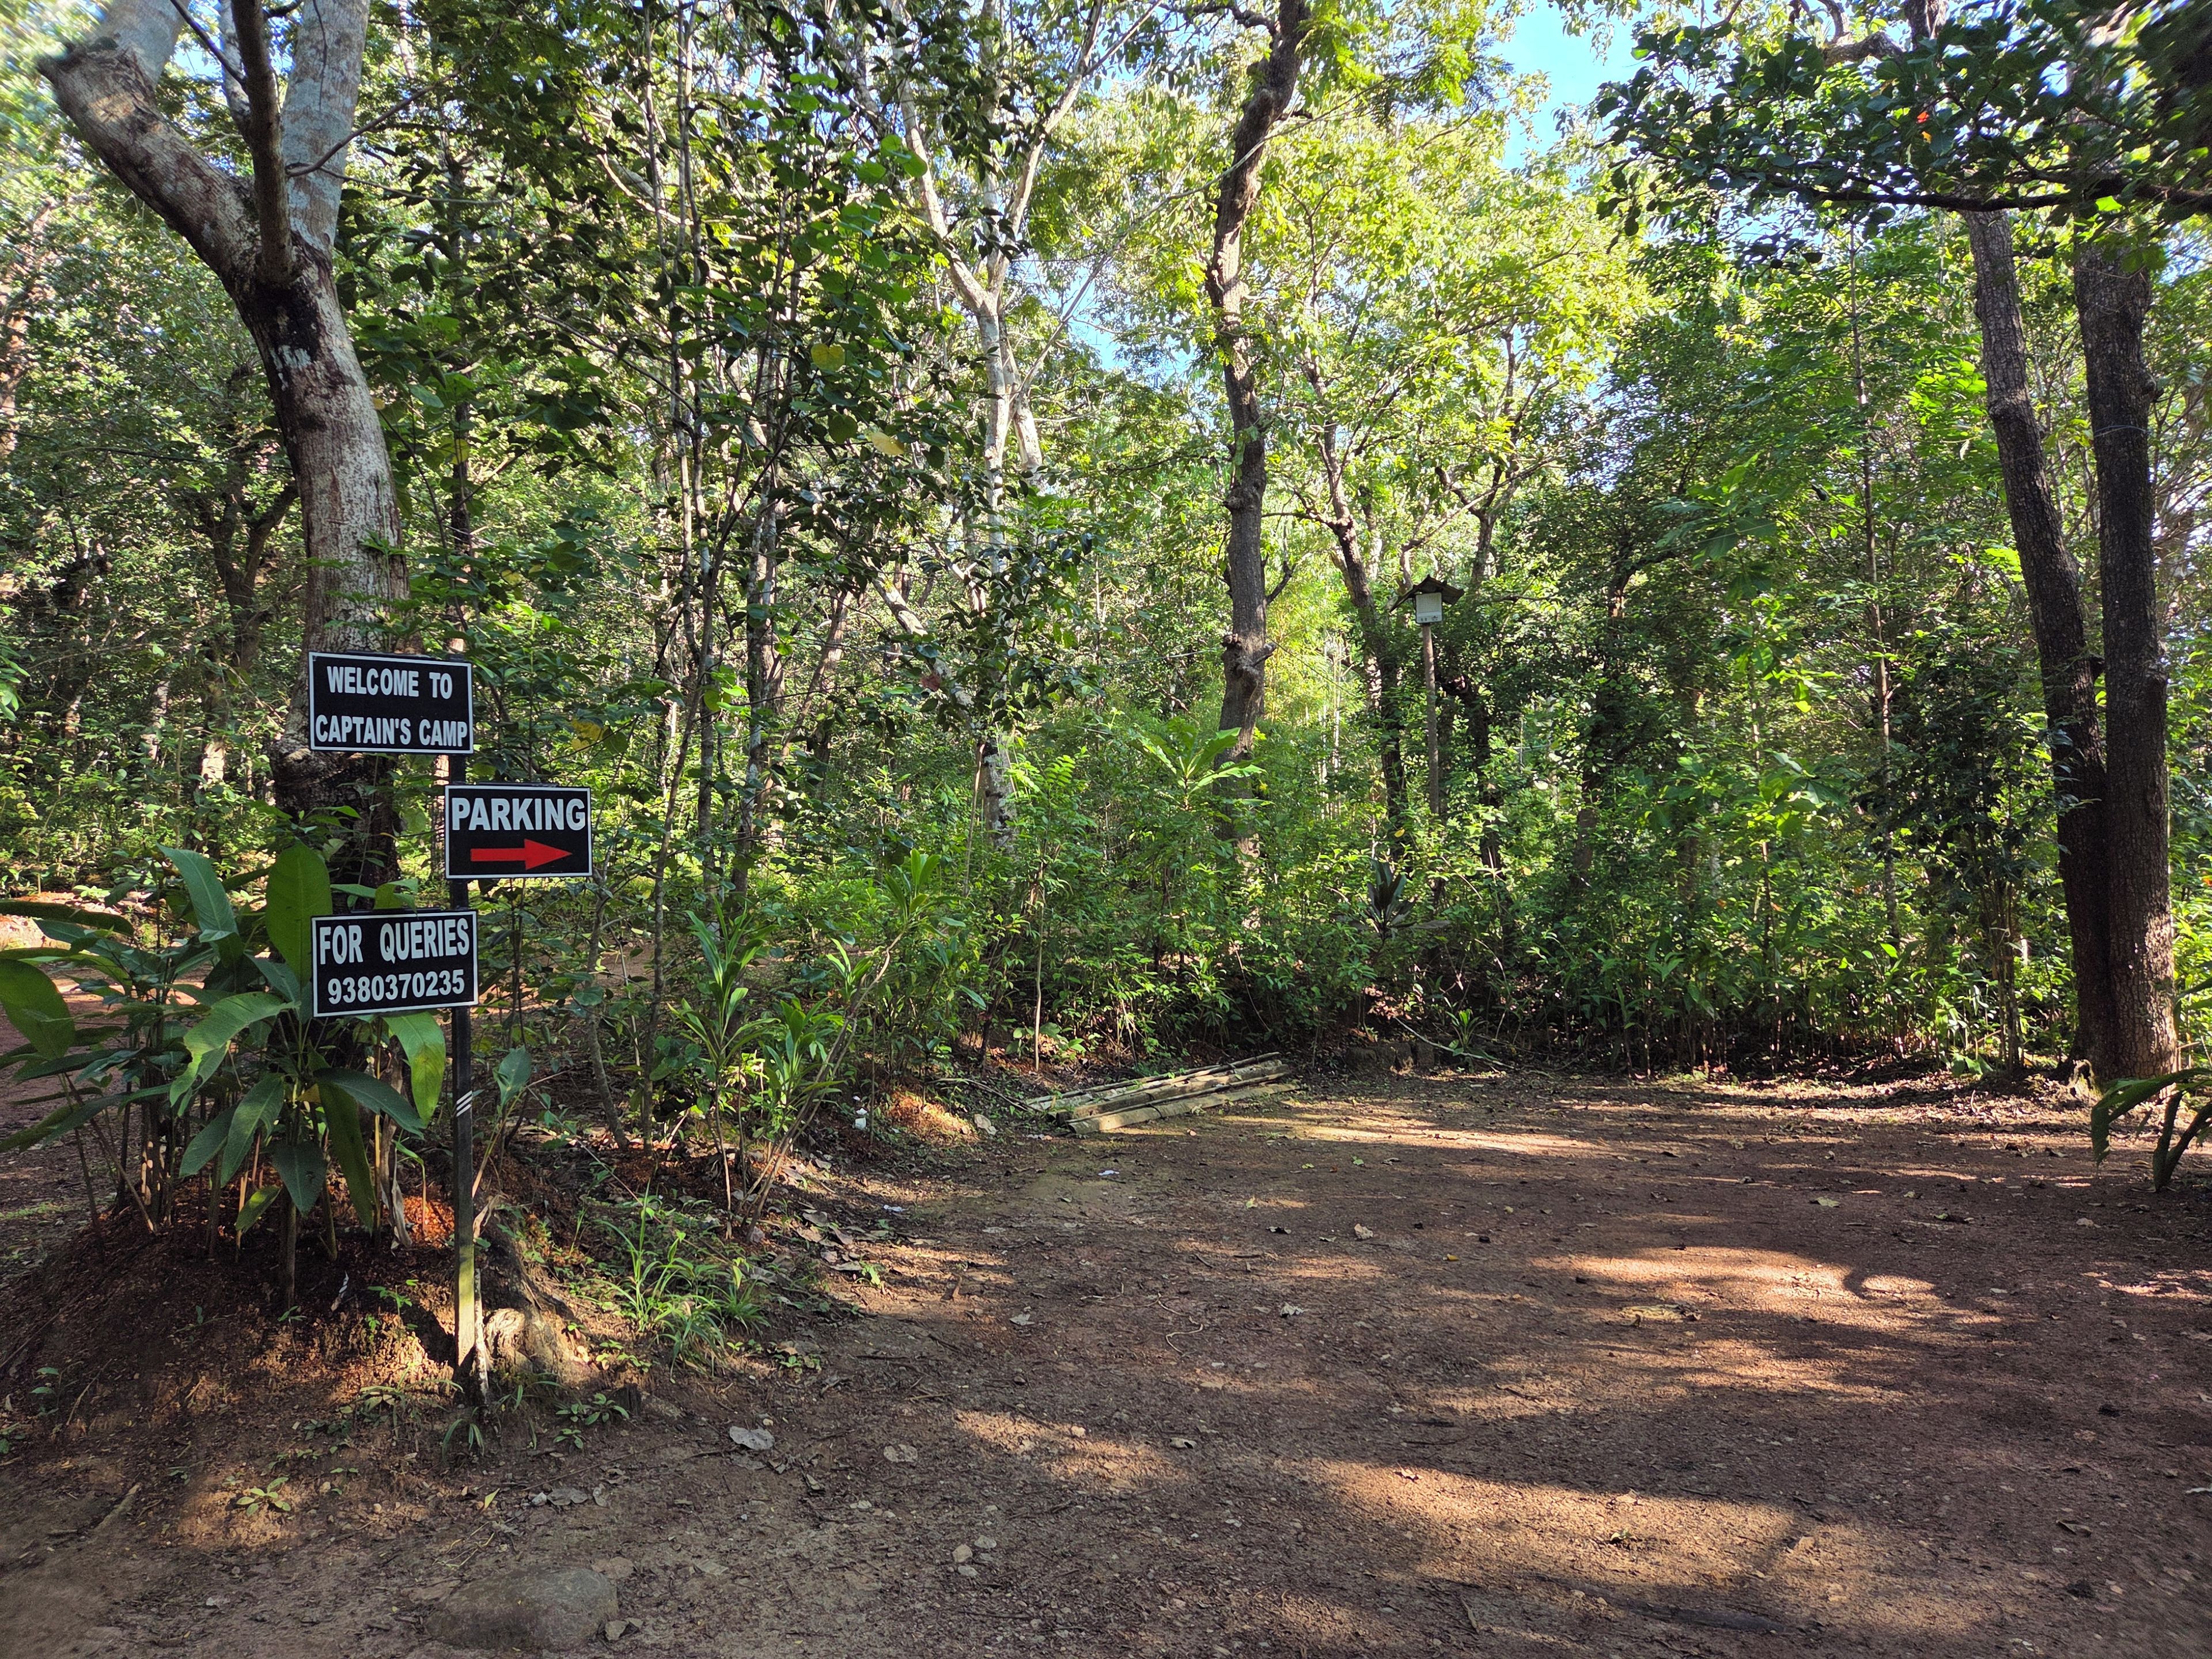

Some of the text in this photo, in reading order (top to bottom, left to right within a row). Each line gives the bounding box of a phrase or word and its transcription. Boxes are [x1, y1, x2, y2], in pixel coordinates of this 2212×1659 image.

[327, 666, 452, 699] WELCOME TO
[315, 715, 467, 747] CAPTAIN'S CAMP
[452, 797, 585, 831] PARKING
[320, 918, 469, 965] FOR QUERIES
[328, 969, 464, 1004] 9380370235
